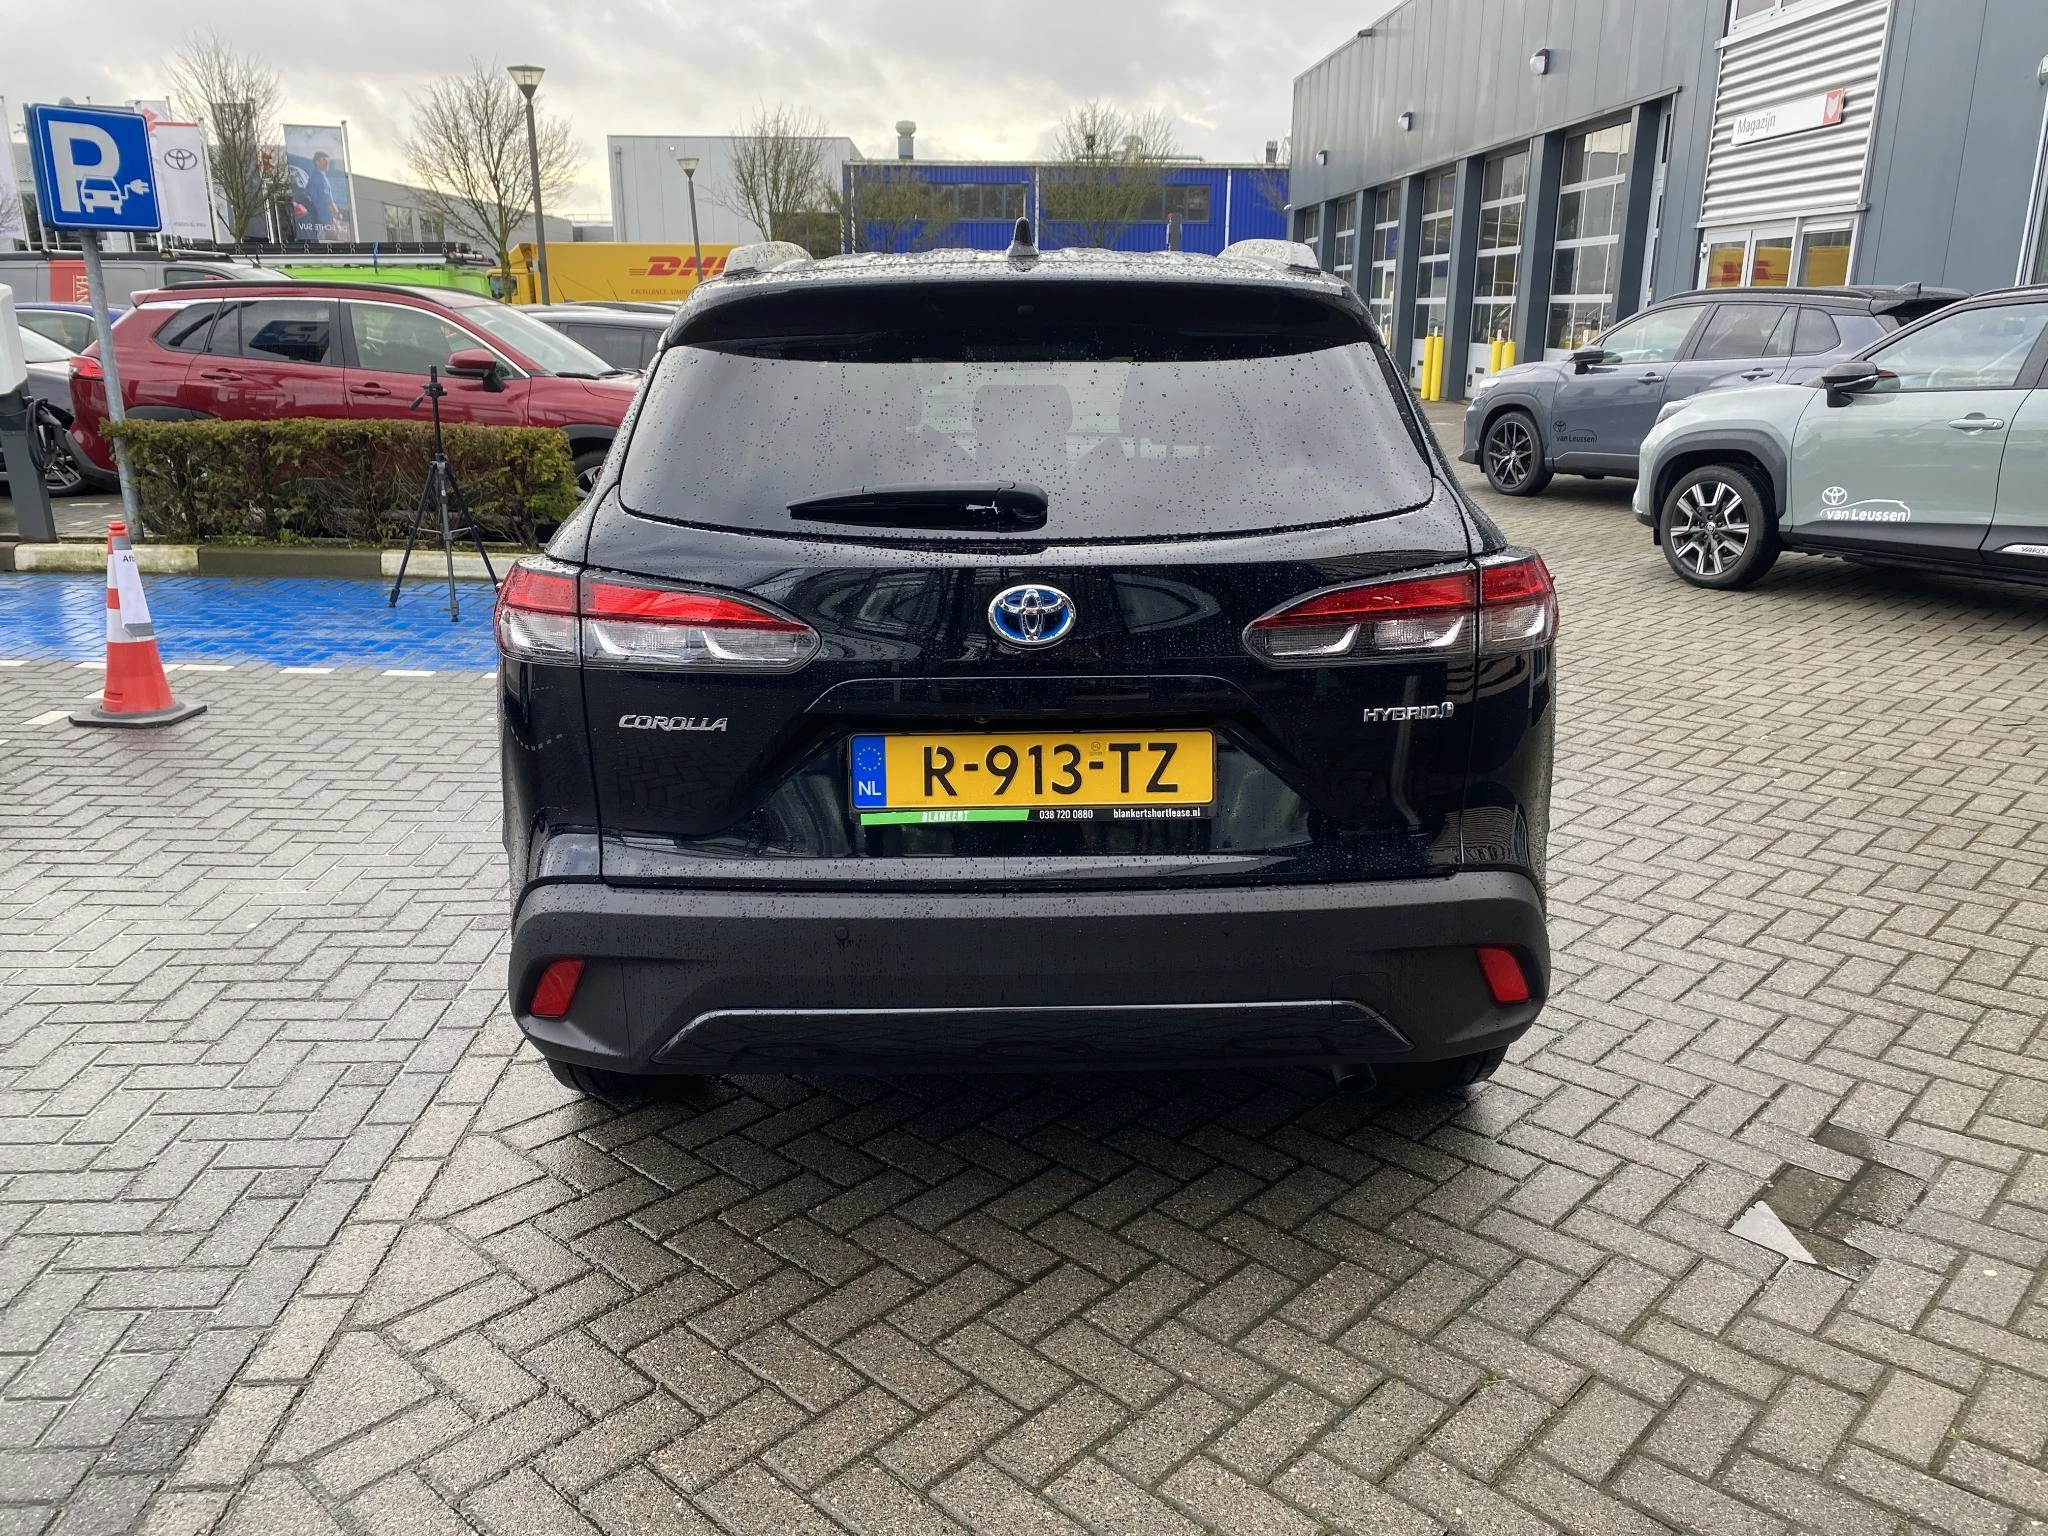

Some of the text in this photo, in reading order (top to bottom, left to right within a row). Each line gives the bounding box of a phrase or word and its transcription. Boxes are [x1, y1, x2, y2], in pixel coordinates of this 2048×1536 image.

[1737, 112, 1776, 136] Magazijn
[48, 120, 120, 213] P
[1827, 508, 1907, 522] van Leussen
[1363, 705, 1440, 722] HYBRID
[618, 714, 728, 732] COROLLA
[922, 742, 1179, 797] R-913-TZ
[858, 780, 882, 797] NL
[921, 810, 969, 823] BLANKERT
[1039, 808, 1201, 820] 038 720 0880 blankertshortlease.nl
